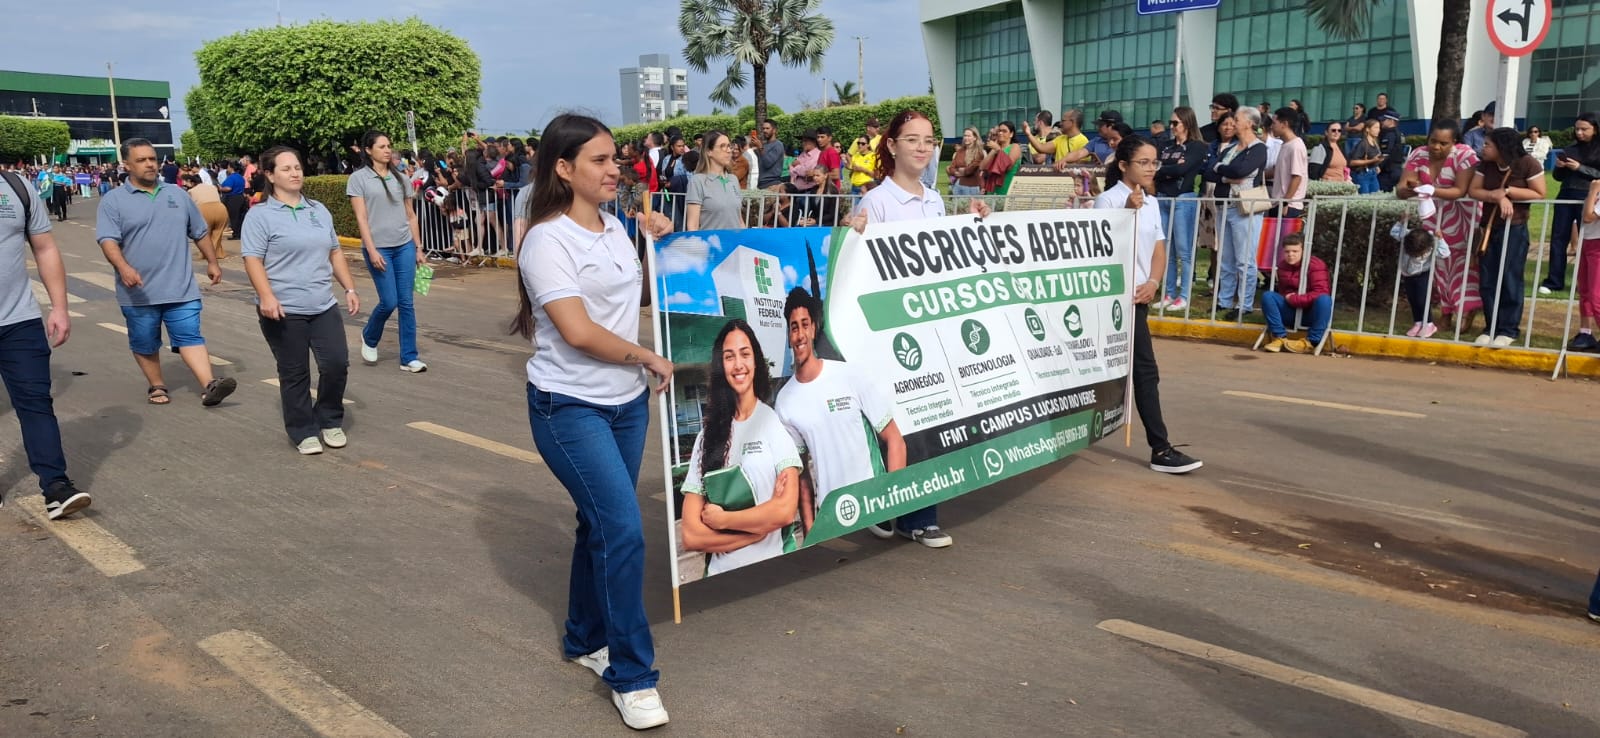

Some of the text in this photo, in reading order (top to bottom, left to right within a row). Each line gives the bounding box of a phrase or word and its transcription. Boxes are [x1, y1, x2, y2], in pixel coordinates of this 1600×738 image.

[866, 217, 1114, 281] INSCRIÇÕES ABERTAS
[753, 297, 783, 309] INSTITUTO
[902, 269, 1111, 319] CURSOS GRATUITOS
[758, 308, 782, 319] FEDERAL
[958, 353, 1016, 379] BIOTECNOLOGIA
[893, 371, 945, 395] AGRONEGÓCIO
[939, 425, 968, 448] IFMT
[980, 405, 1033, 434] CAMPUS
[1032, 398, 1060, 418] LUCAS
[1058, 395, 1069, 411] DO
[1005, 436, 1058, 464] WhatsApp
[863, 466, 965, 515] lrv.ifmt.edu.br
